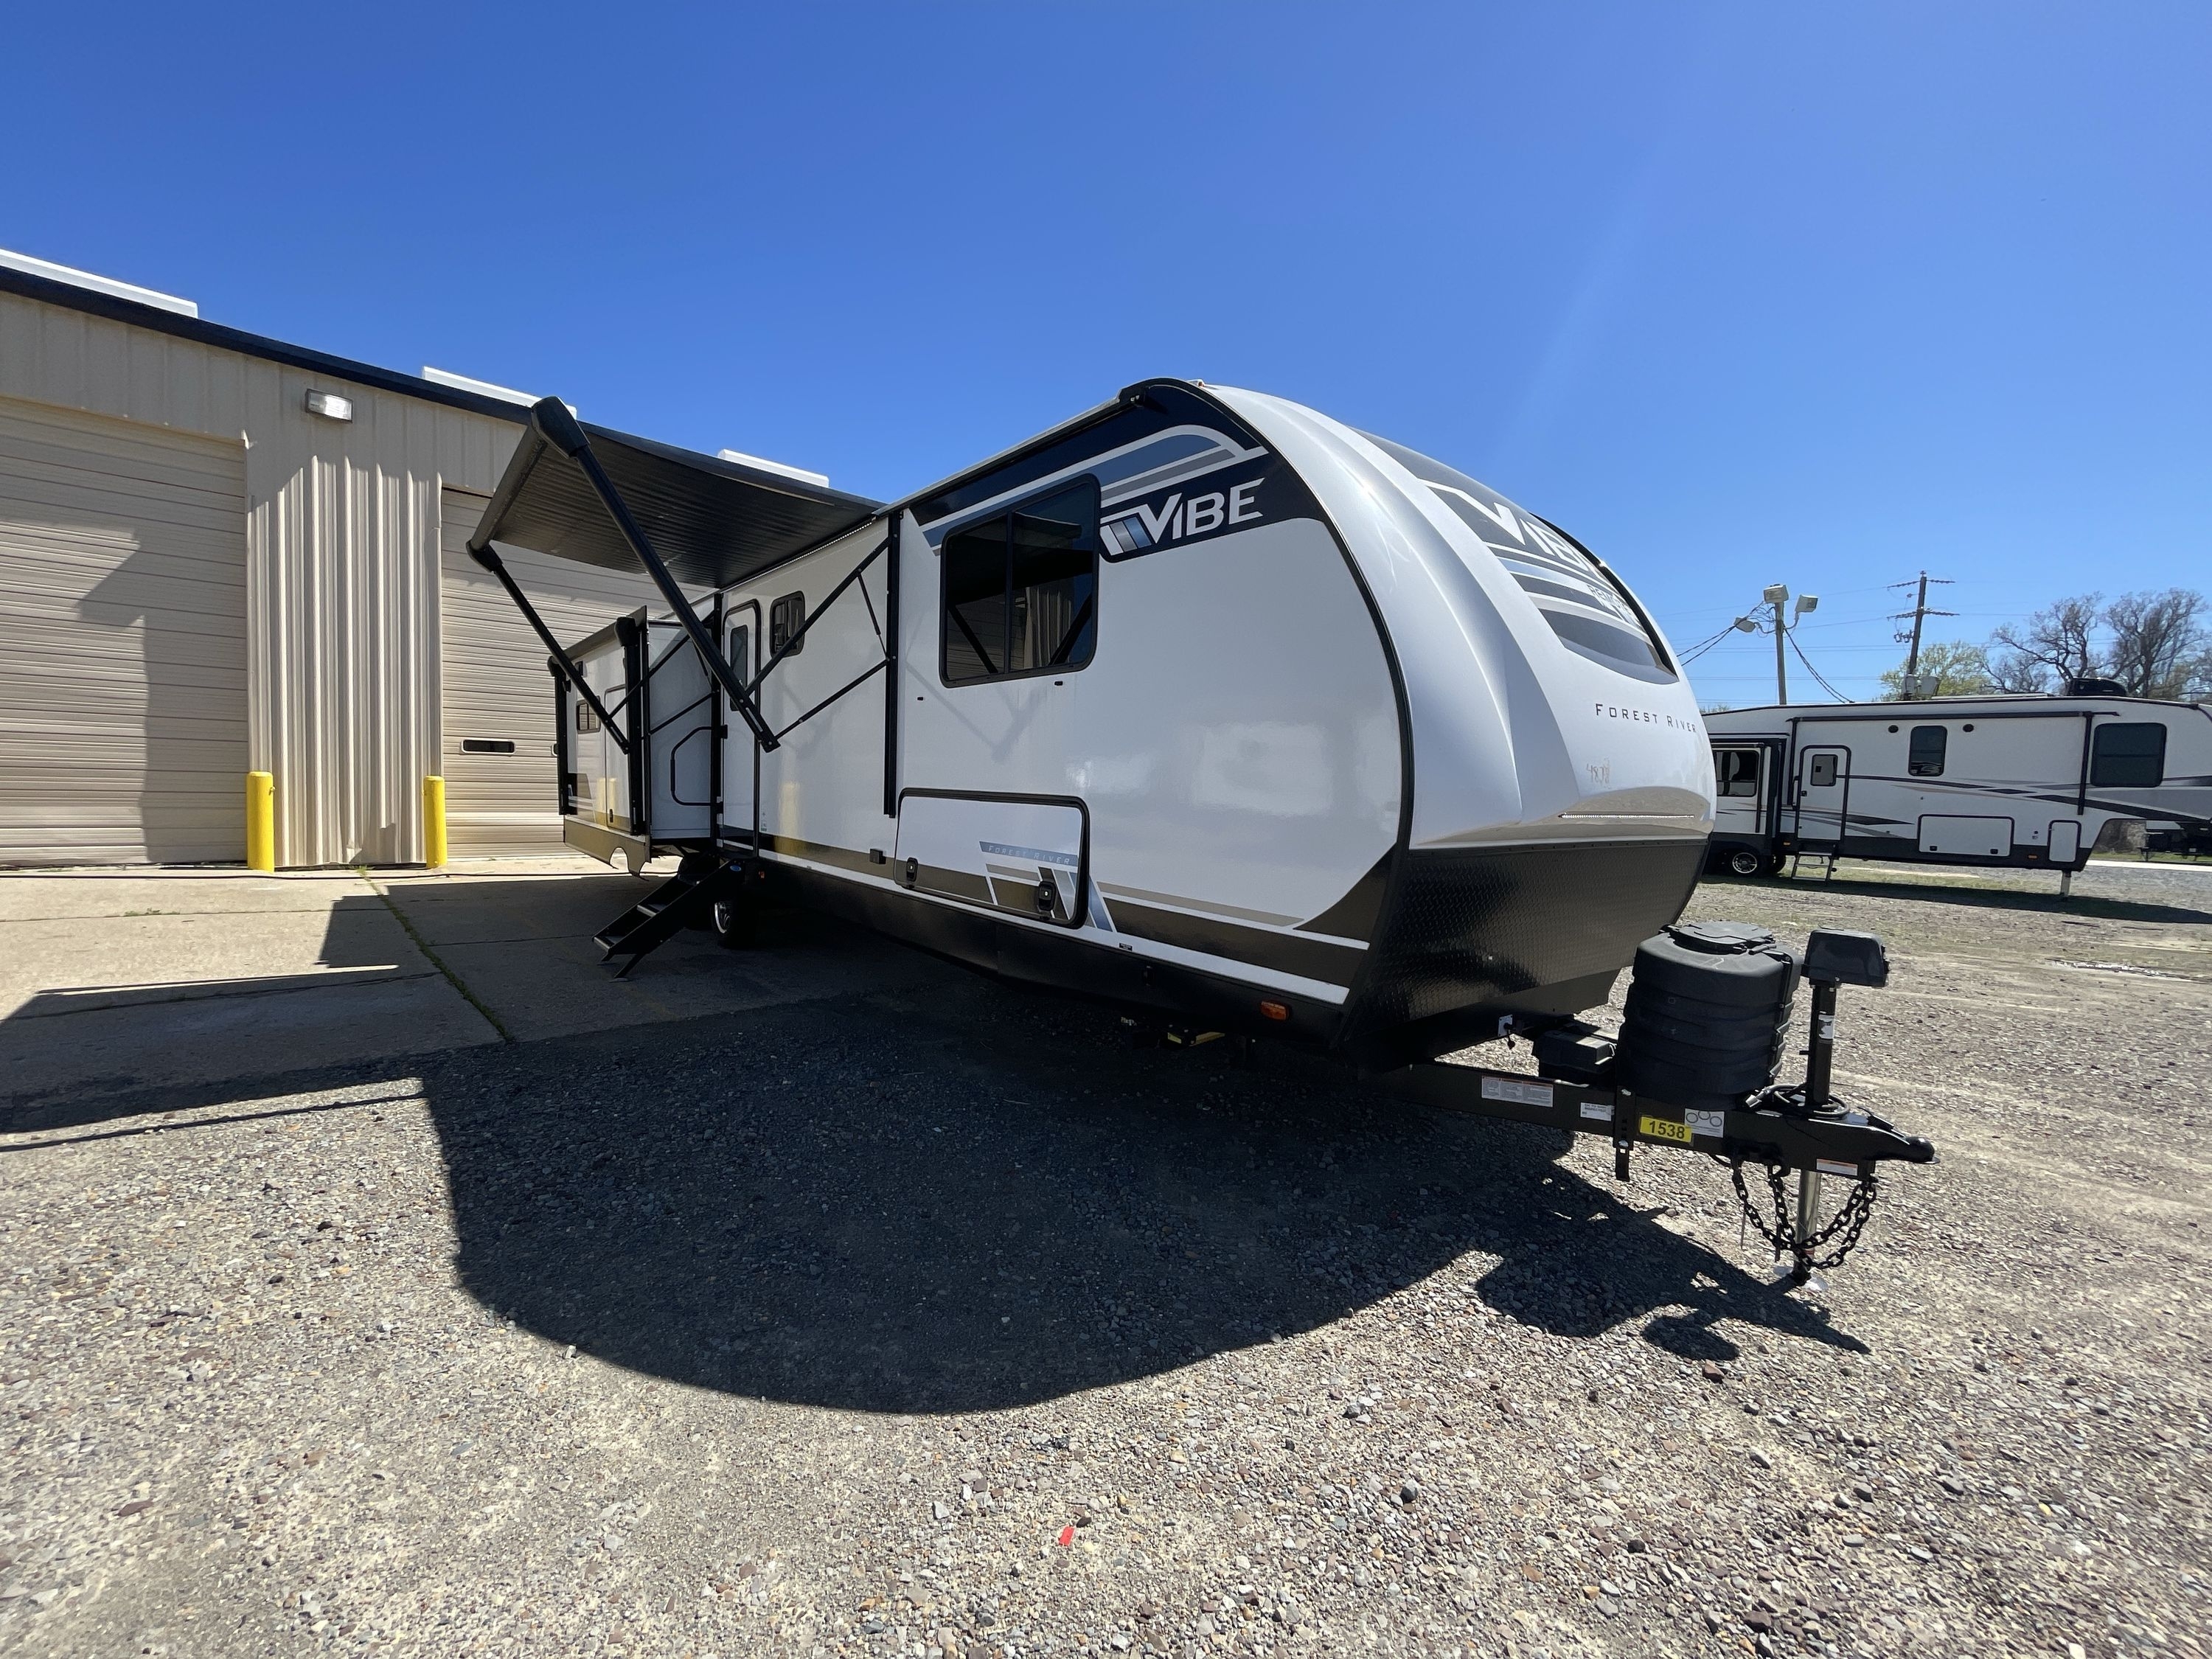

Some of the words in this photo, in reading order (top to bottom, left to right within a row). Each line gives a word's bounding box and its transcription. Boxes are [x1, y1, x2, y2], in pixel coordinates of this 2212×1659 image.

[1139, 478, 1265, 544] VIBE
[1596, 703, 1658, 724] FOREST
[1666, 715, 1696, 732] RIVER
[988, 845, 1026, 857] FOREST
[1034, 852, 1070, 864] RIVER
[1649, 1120, 1685, 1139] 1538
